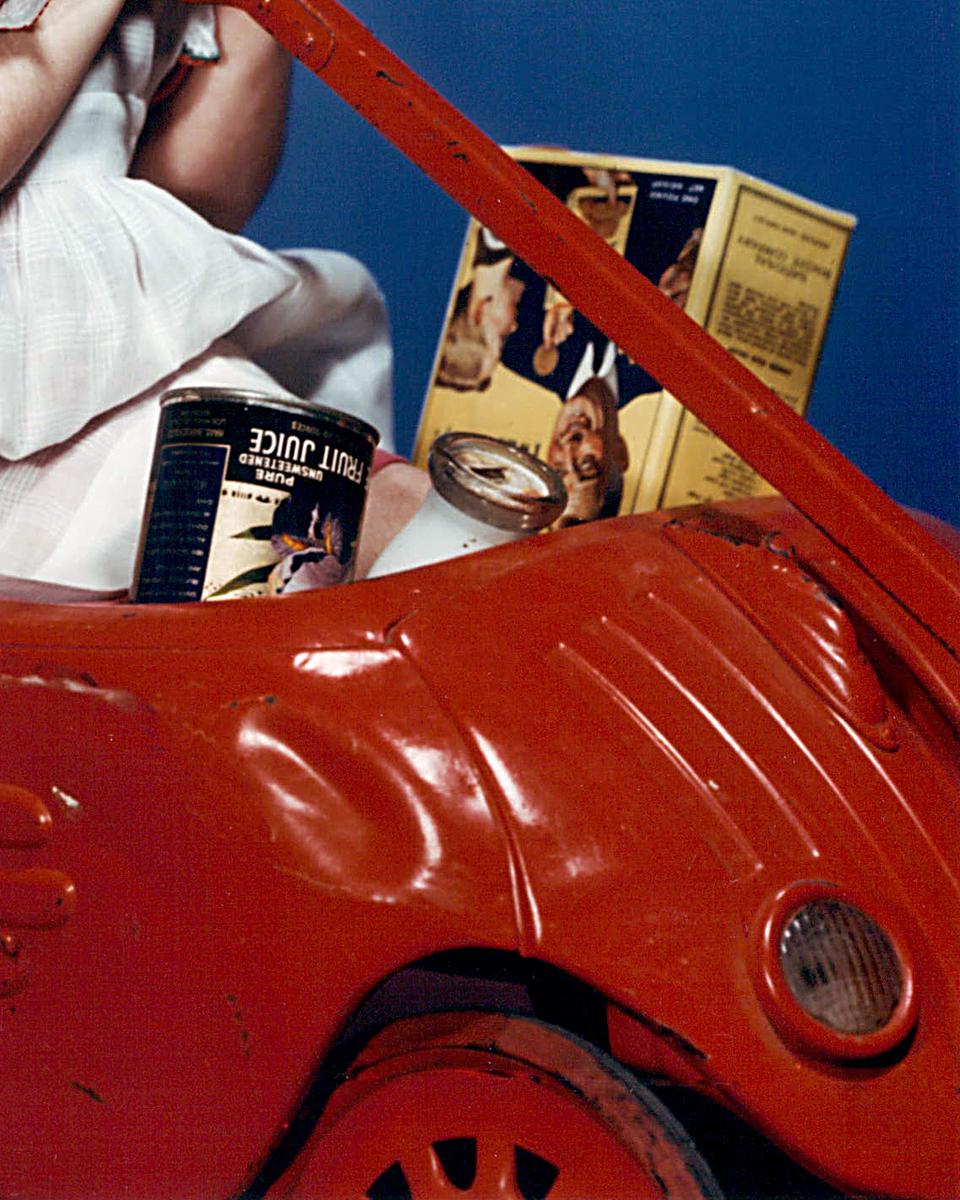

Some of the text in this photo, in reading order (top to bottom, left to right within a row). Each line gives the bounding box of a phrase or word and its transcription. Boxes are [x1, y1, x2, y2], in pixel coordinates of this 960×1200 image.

[239, 453, 324, 482] UNSWEETENED
[249, 428, 364, 484] FRUIT JUICE
[255, 468, 295, 487] PURE
